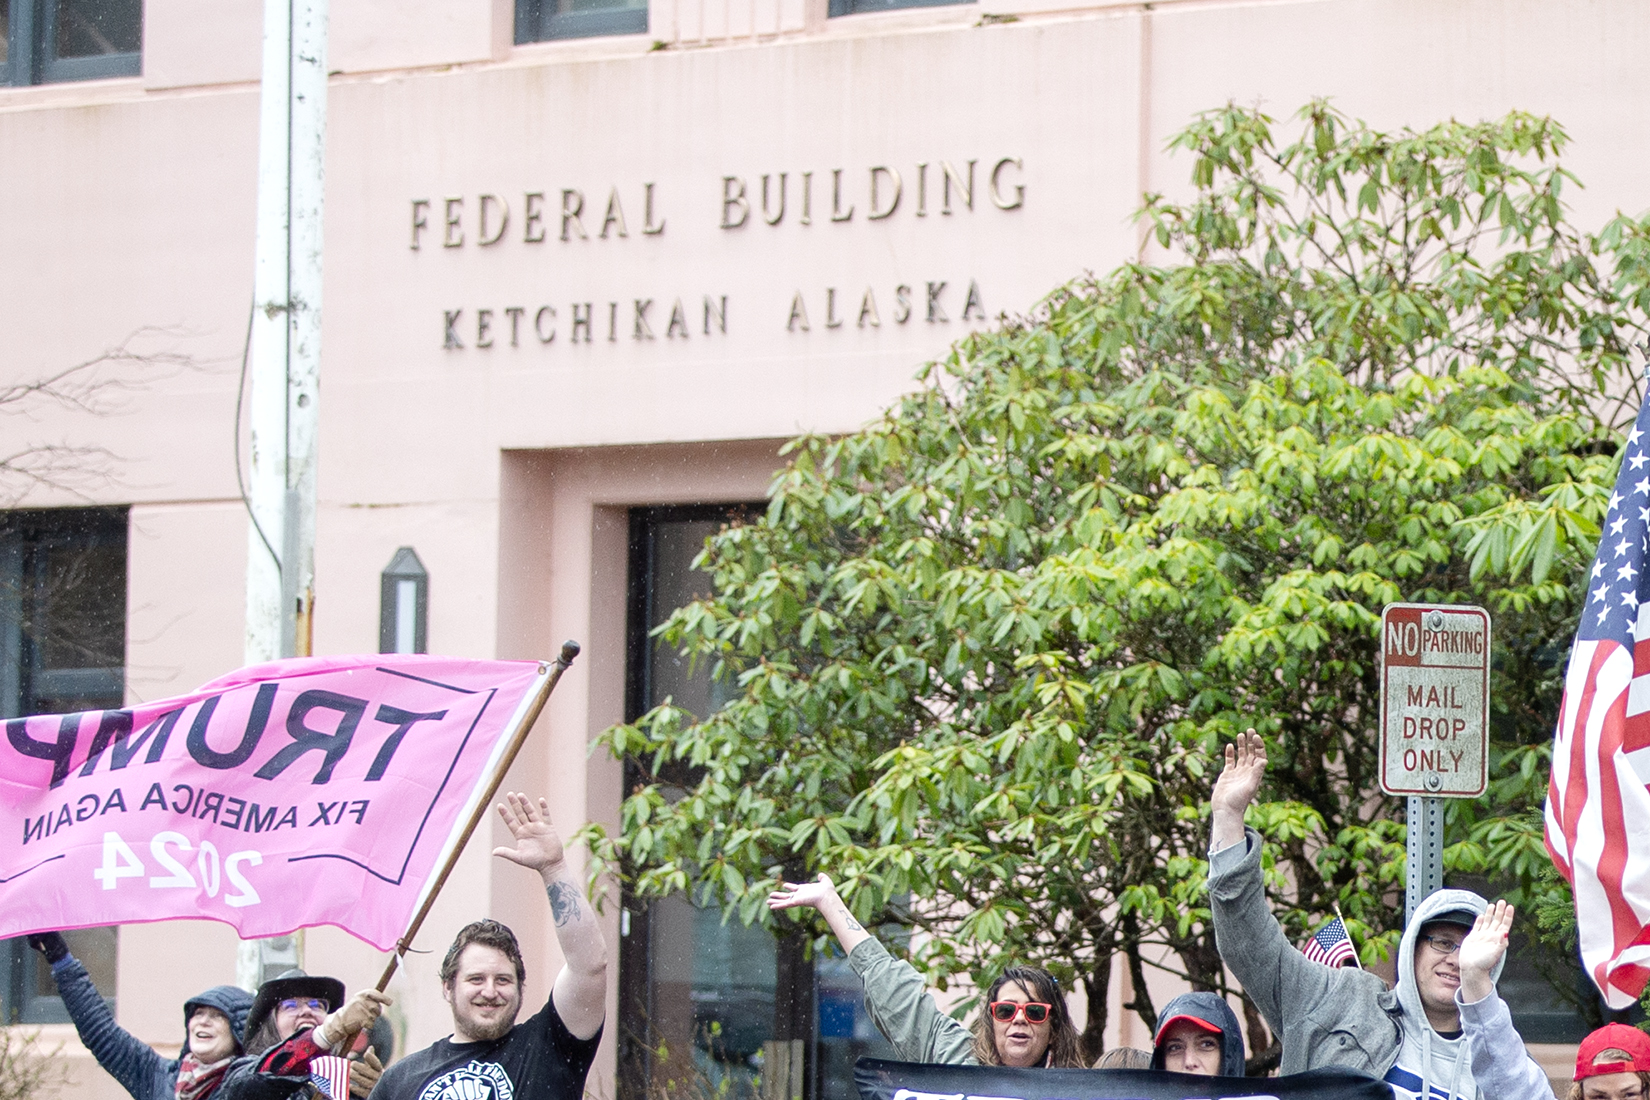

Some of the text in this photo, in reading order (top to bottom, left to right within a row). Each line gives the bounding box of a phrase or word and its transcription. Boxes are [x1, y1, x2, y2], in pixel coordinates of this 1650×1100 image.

[409, 155, 1028, 251] FEDERAL BUILDING
[441, 277, 988, 351] KETCHIKAN ALASKA
[1388, 621, 1483, 657] NO PARKING
[1407, 684, 1463, 709] MAIL
[1403, 716, 1466, 741] DROP
[1403, 748, 1464, 773] ONLY
